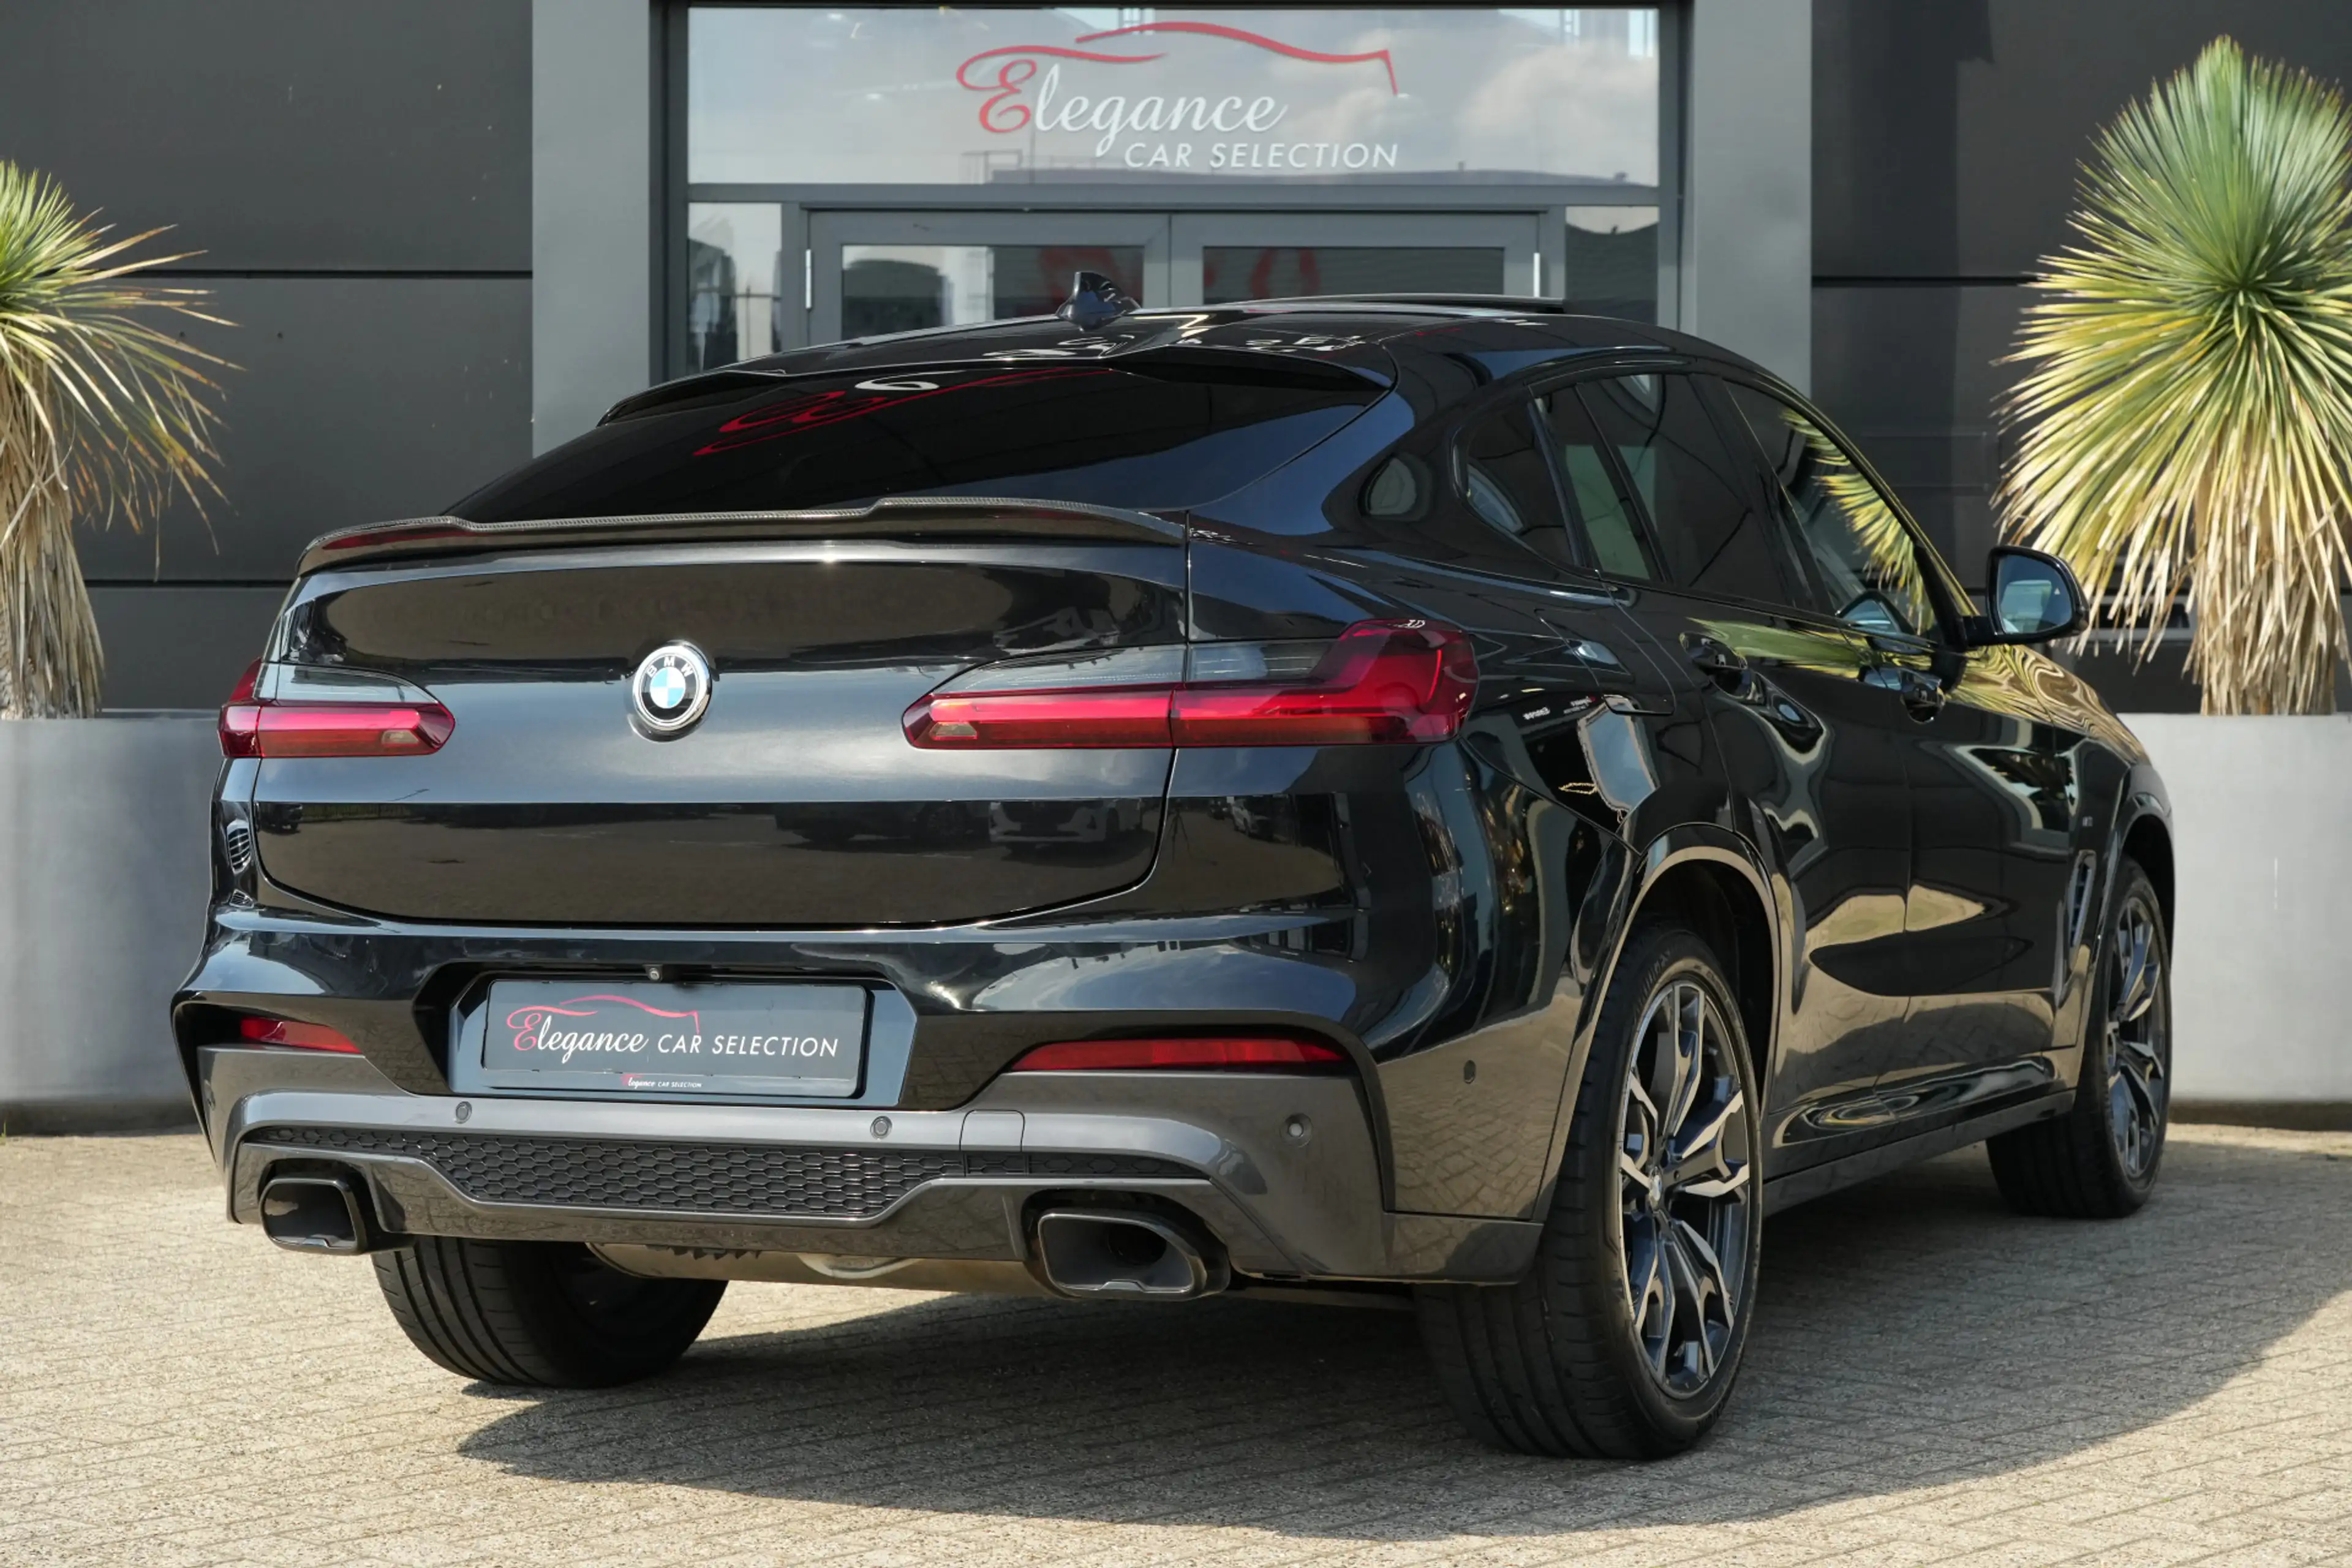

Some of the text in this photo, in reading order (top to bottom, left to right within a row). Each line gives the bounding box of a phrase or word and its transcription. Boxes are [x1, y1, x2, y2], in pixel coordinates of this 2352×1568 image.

[957, 46, 1289, 157] Elegance
[1125, 143, 1398, 168] CAR SELECTION
[647, 655, 694, 677] BMW
[507, 1006, 838, 1064] Elegance CAR SELECTION
